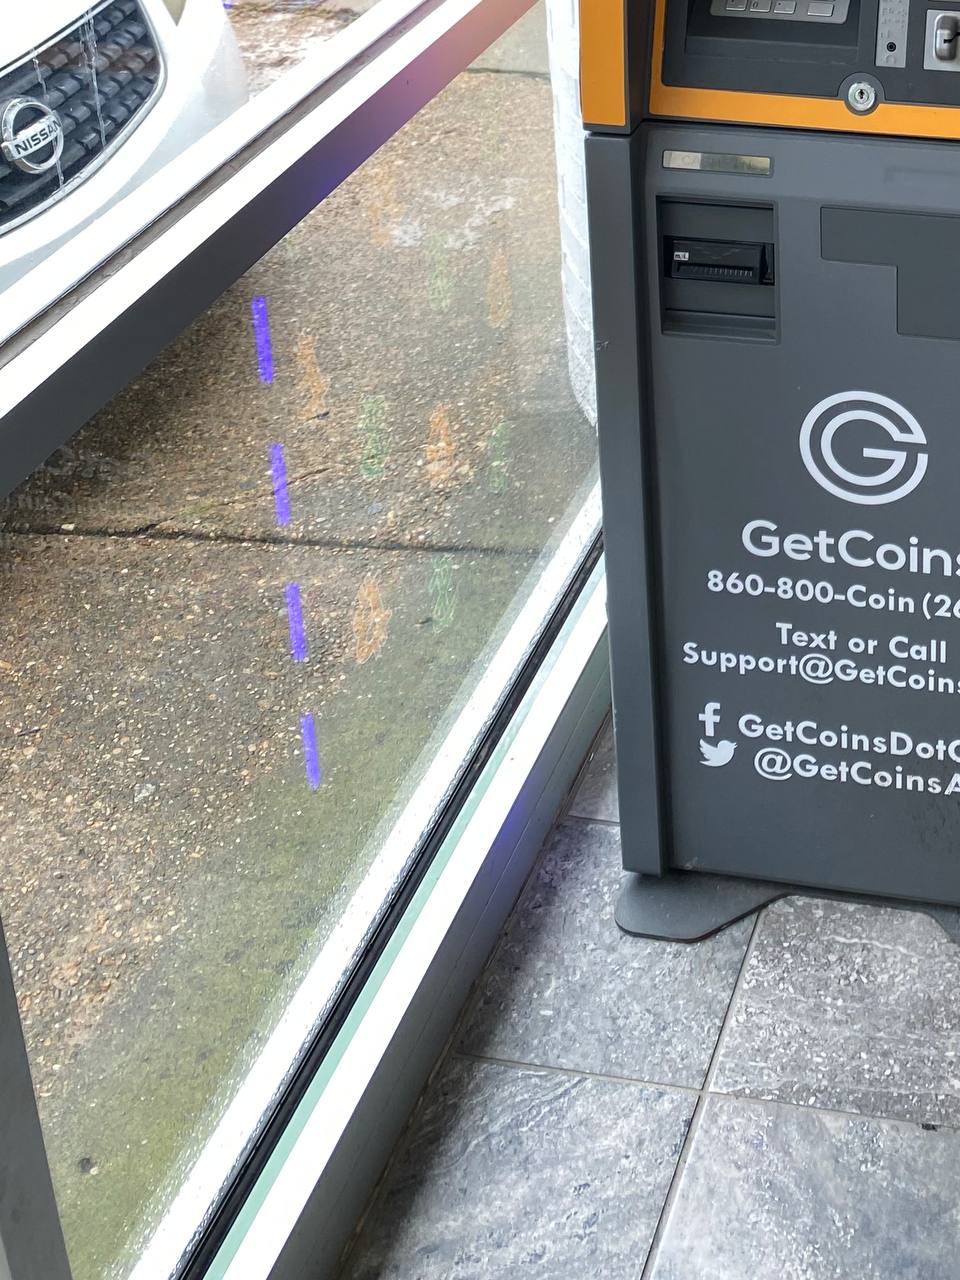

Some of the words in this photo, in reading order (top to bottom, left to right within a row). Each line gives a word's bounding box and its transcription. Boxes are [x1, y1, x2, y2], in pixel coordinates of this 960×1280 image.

[14, 120, 61, 154] NISSAN
[706, 570, 915, 613] 860-800-Coin
[775, 622, 838, 650] Text
[848, 633, 878, 655] or
[888, 636, 947, 663] Call
